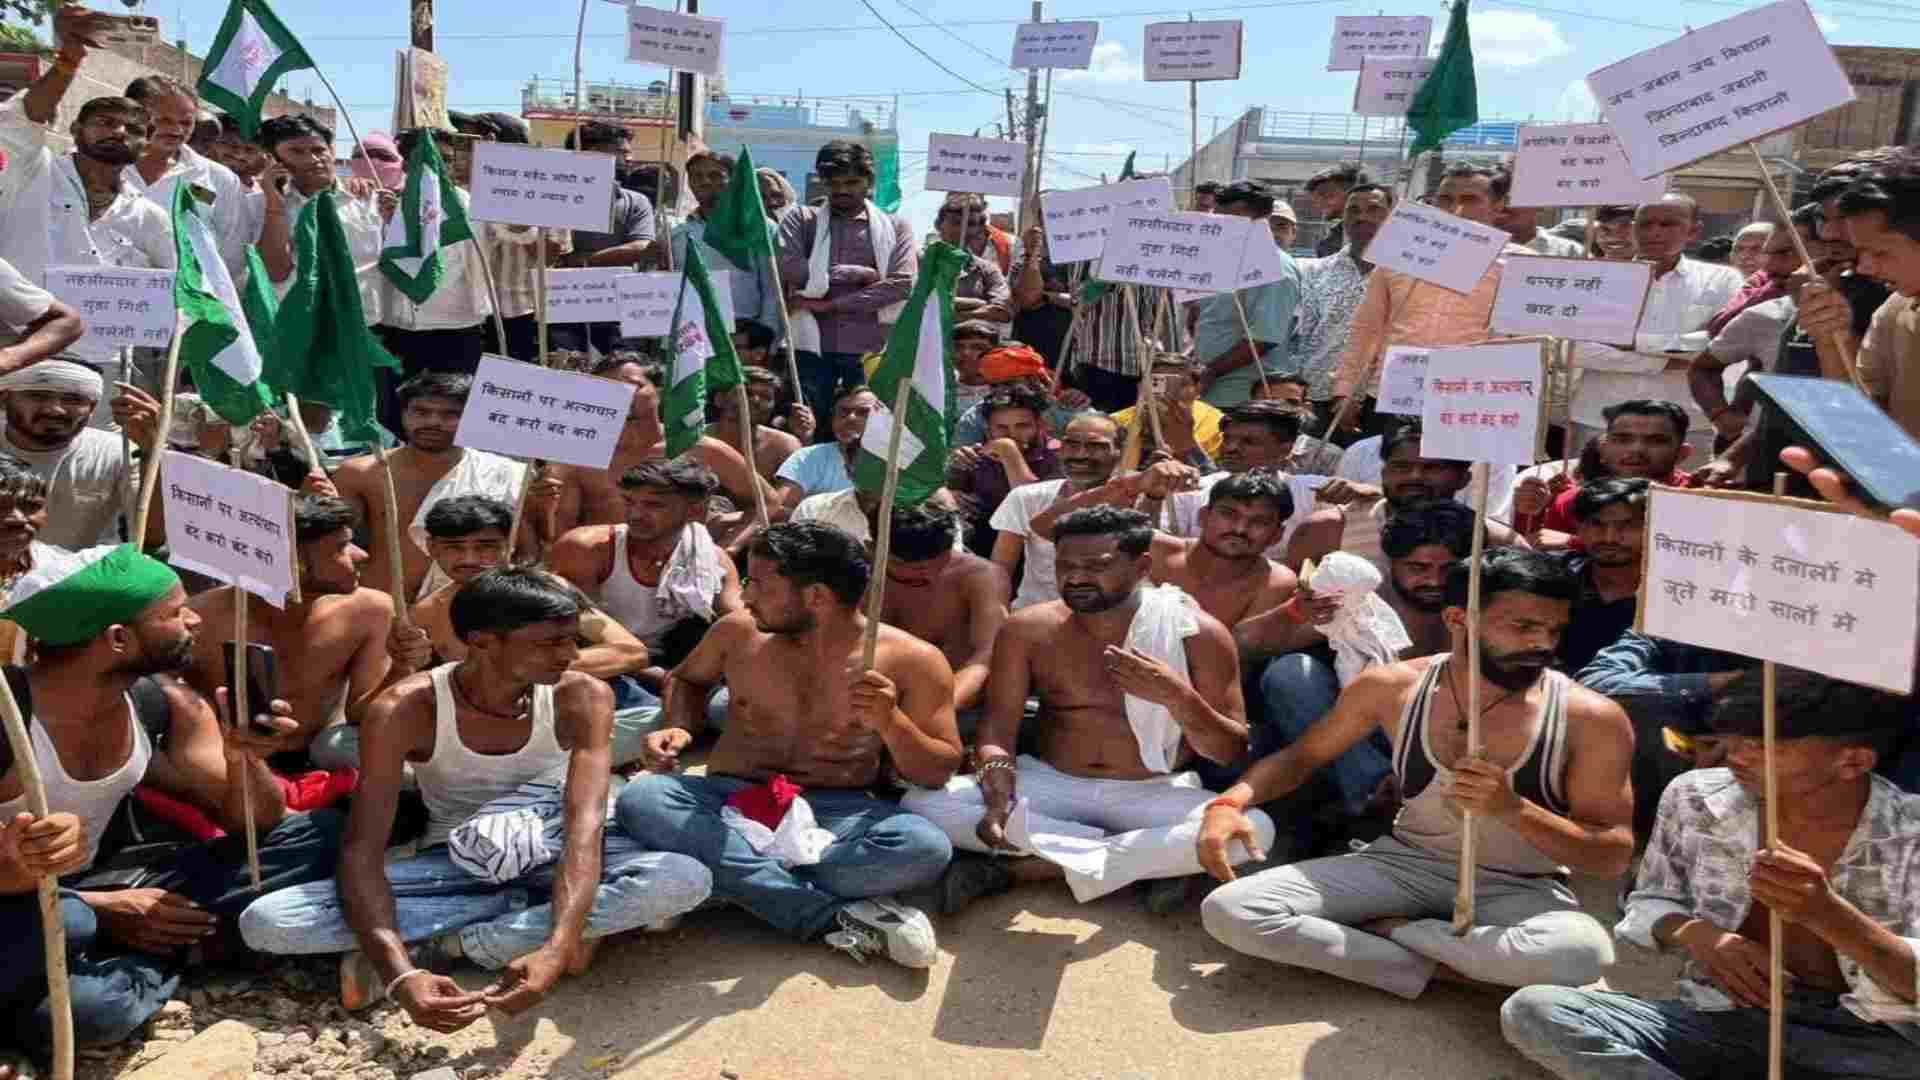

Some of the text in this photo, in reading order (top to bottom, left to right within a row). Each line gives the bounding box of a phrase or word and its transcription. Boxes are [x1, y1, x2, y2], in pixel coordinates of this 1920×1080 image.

[540, 394, 560, 409] पर
[218, 500, 233, 518] पर
[1737, 544, 1759, 568] के
[1664, 578, 1698, 605] जूते
